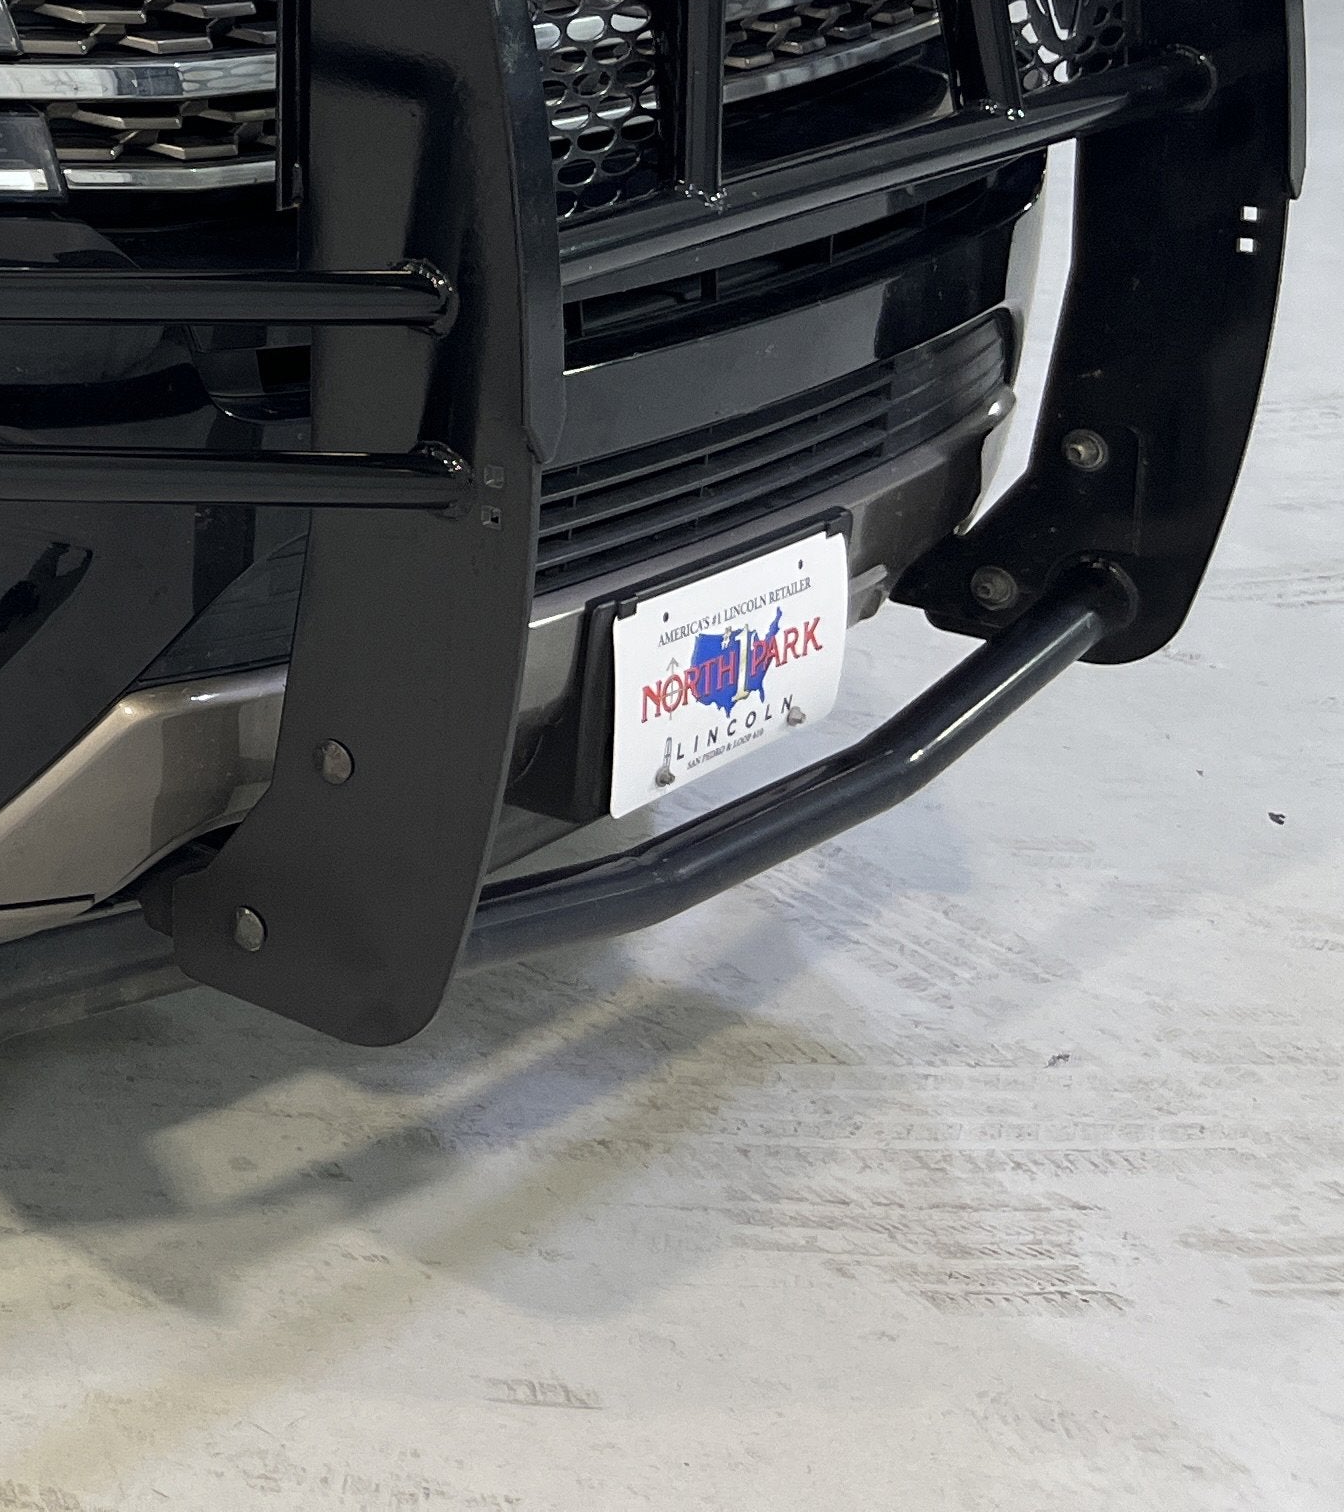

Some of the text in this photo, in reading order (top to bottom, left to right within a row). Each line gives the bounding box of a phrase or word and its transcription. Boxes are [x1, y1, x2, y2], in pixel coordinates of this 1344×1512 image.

[657, 576, 812, 647] AMERICA'S #1 LINCOLN RETAILER
[641, 651, 737, 723] NORTH
[750, 616, 824, 677] PARK
[676, 694, 793, 761] LINCOLN
